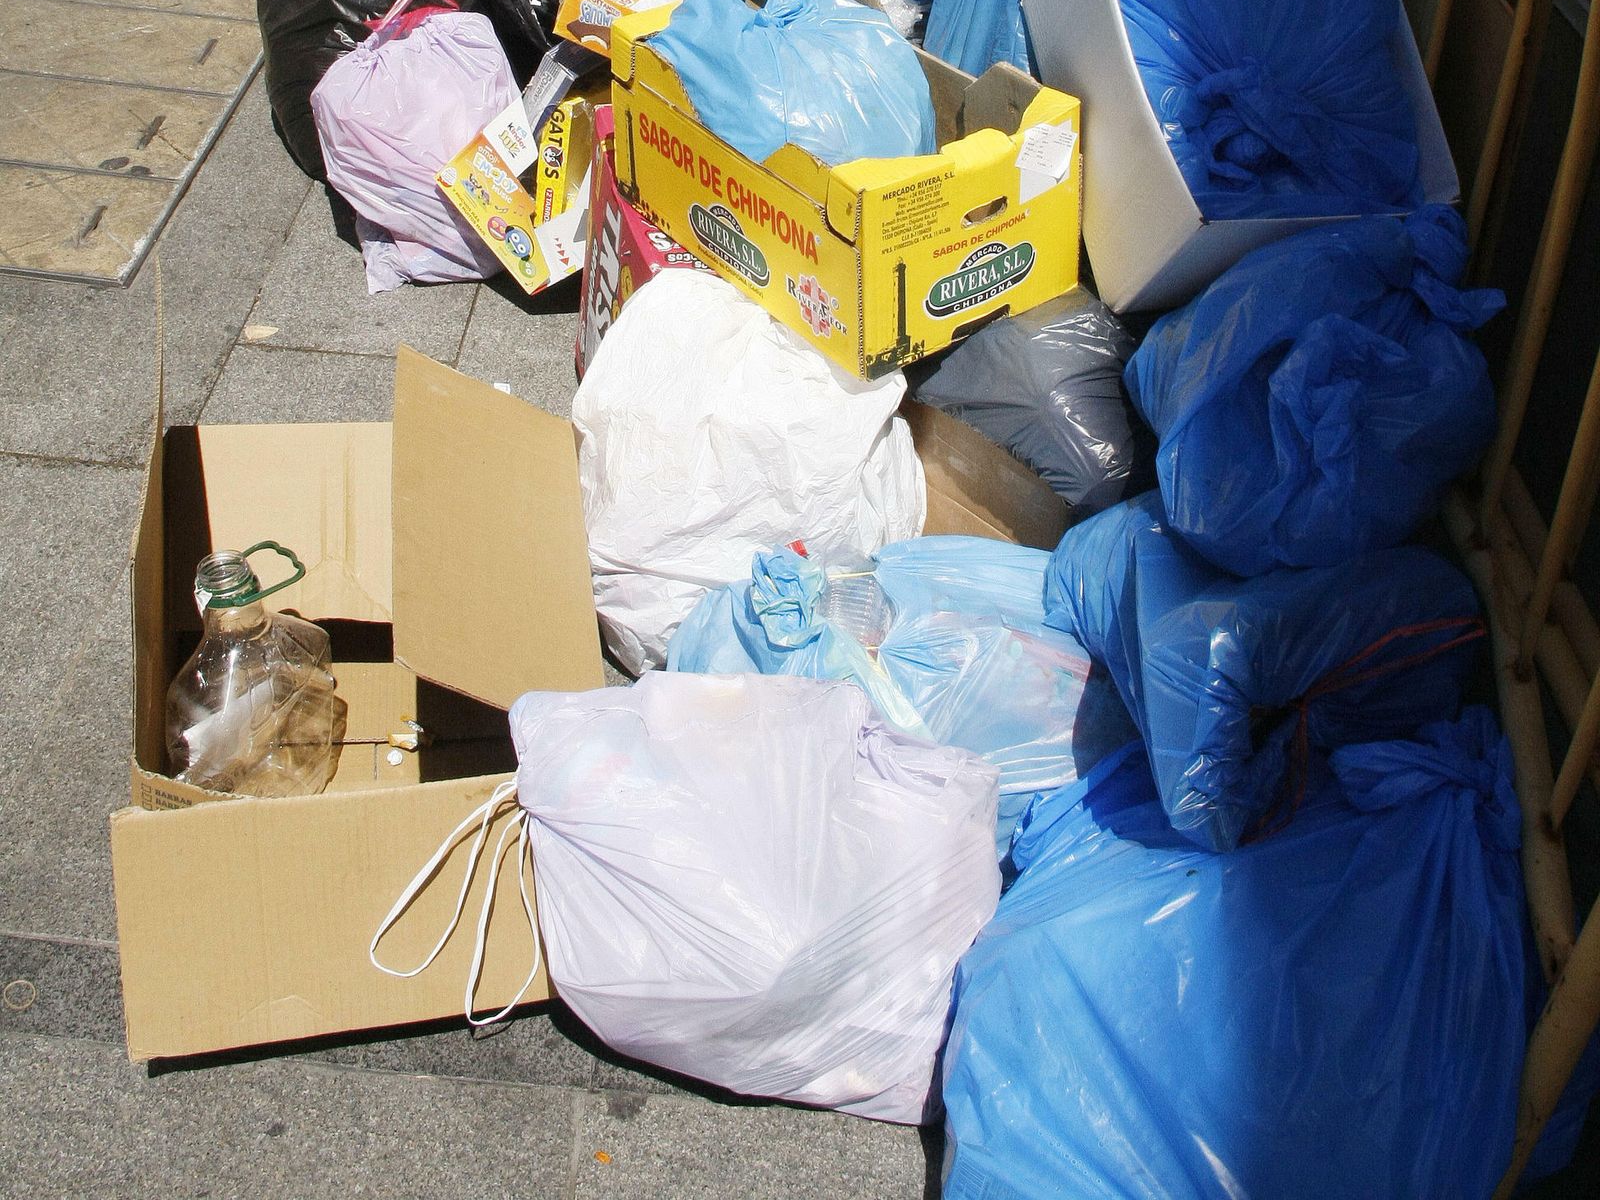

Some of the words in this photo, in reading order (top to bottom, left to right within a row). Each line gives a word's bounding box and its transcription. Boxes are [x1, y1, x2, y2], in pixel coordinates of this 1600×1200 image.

[639, 112, 695, 178] SABOR
[698, 155, 723, 198] DE
[726, 177, 819, 266] CHIPIONA
[882, 183, 915, 201] MERCADO
[698, 210, 741, 259] RIVERA,
[932, 241, 968, 259] SABOR
[970, 234, 984, 246] DE
[985, 213, 1026, 239] CHIPIONA
[708, 242, 753, 281] CHIPIONA
[939, 264, 1001, 302] RIVERA,
[1003, 250, 1026, 275] S.L.
[965, 245, 1002, 267] MERCADO
[953, 280, 1013, 311] CHIPIONA
